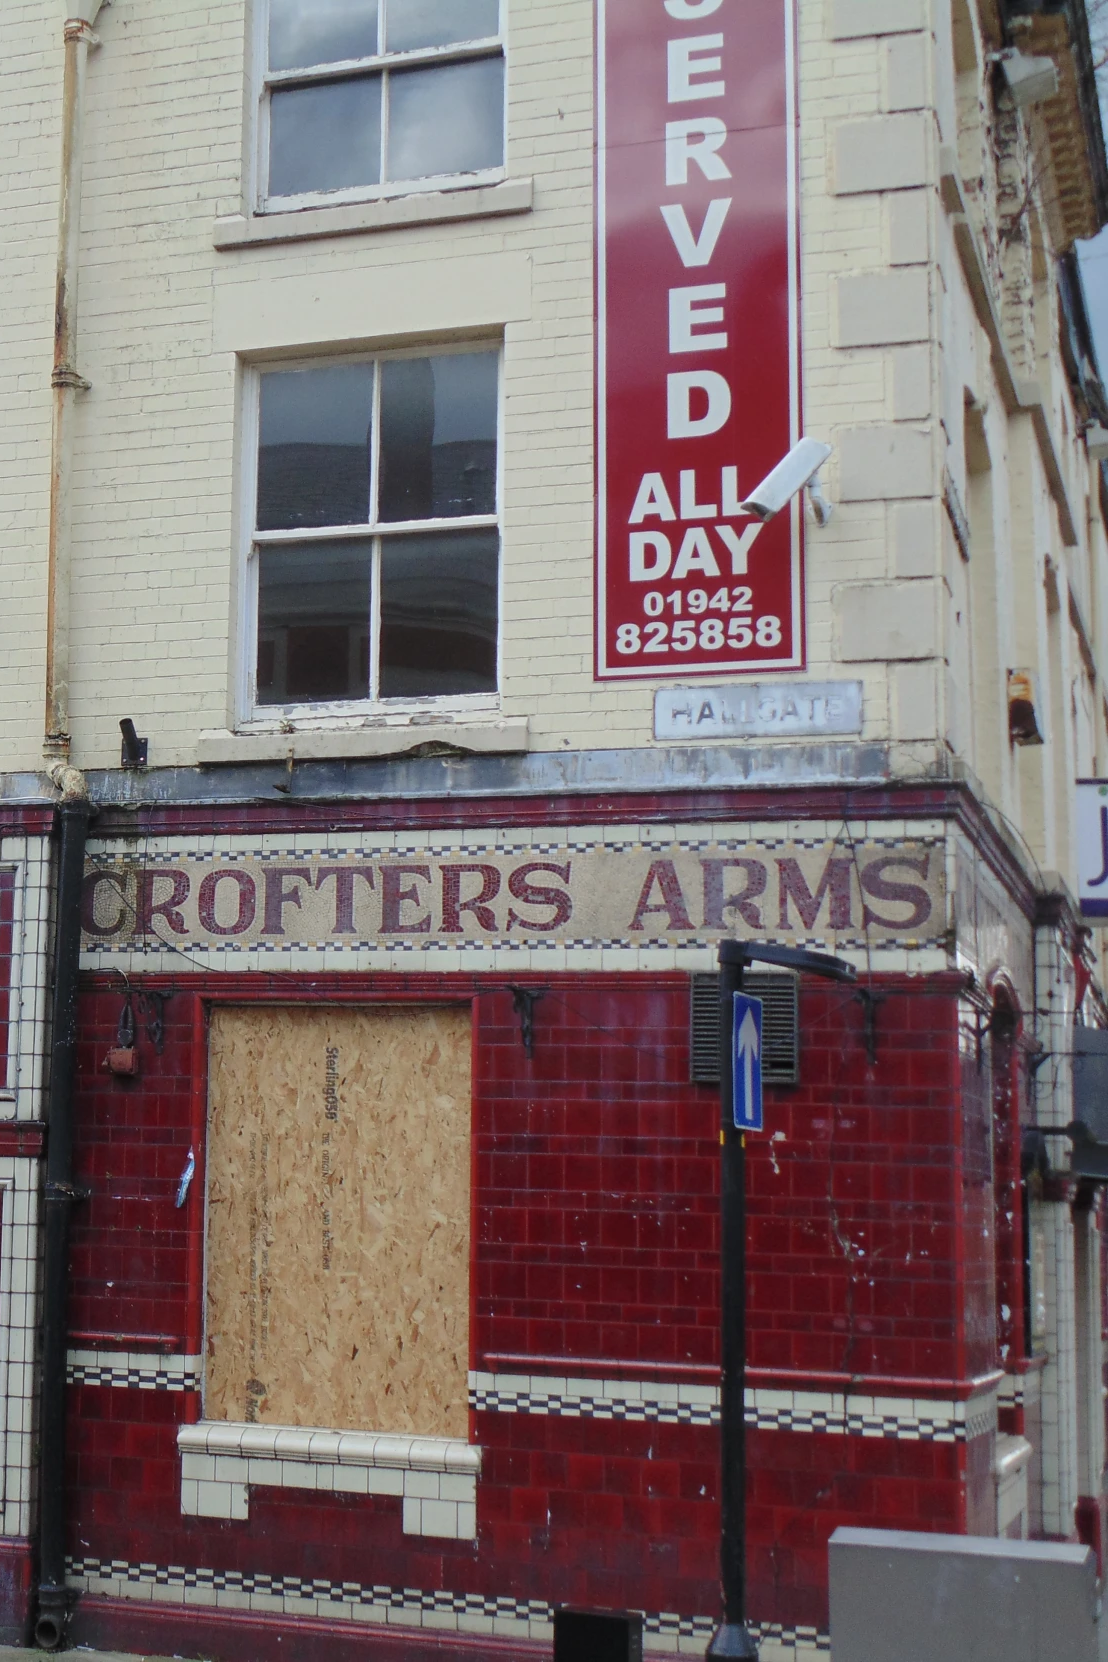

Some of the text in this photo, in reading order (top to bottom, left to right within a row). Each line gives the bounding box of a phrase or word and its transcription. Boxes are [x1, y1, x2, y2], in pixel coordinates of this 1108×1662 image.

[628, 465, 753, 524] ALL
[629, 522, 764, 582] DAY
[643, 586, 753, 617] 01942
[616, 615, 782, 654] 825858
[80, 852, 933, 937] CROFTERS ARMS
